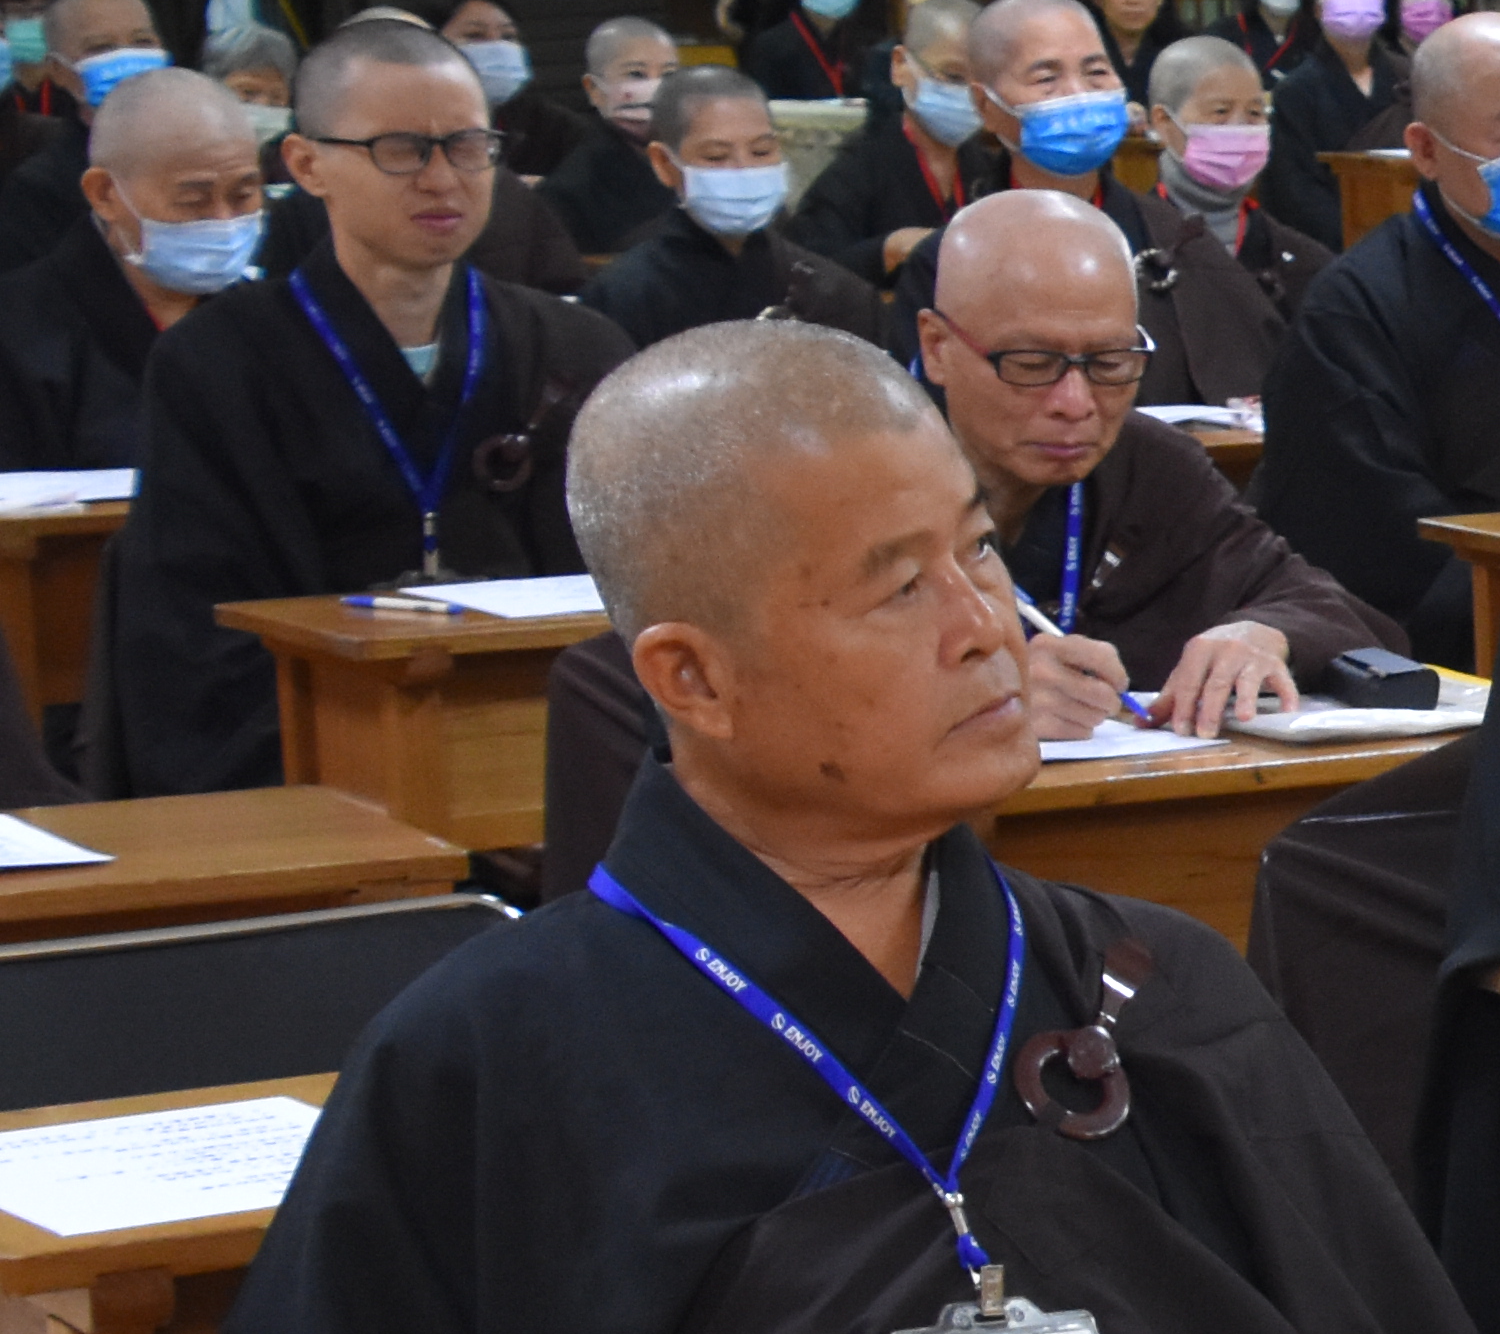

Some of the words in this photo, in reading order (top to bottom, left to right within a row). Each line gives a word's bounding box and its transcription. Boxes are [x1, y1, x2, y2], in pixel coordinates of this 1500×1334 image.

[707, 957, 748, 994] ENJOY
[784, 1025, 824, 1063] ENJOY
[990, 1031, 1006, 1068] ENJOY
[859, 1099, 897, 1139] ENJOY
